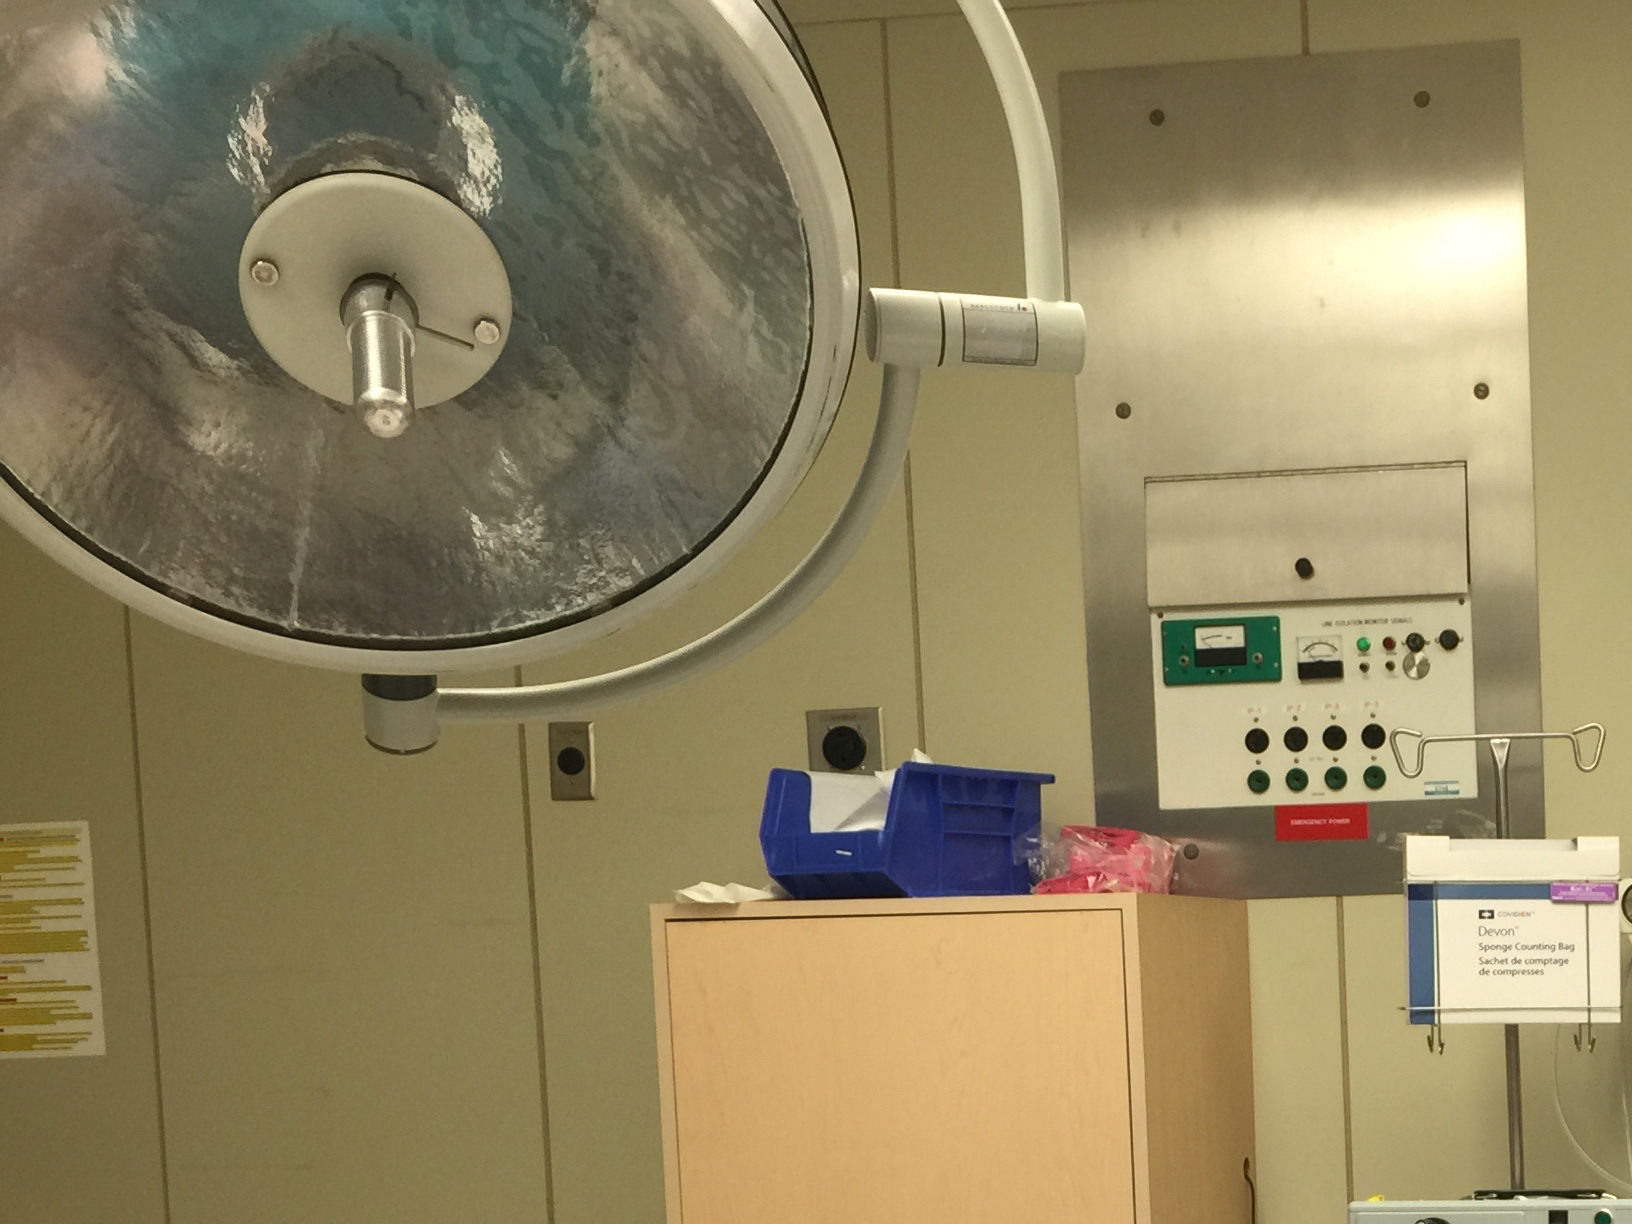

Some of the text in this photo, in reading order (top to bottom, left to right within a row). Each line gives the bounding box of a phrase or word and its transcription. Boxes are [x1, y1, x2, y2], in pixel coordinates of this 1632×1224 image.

[1478, 942, 1575, 953] Sponge Counting Bag
[1478, 956, 1569, 967] Sachet de comptage
[1478, 967, 1544, 977] de compresses
